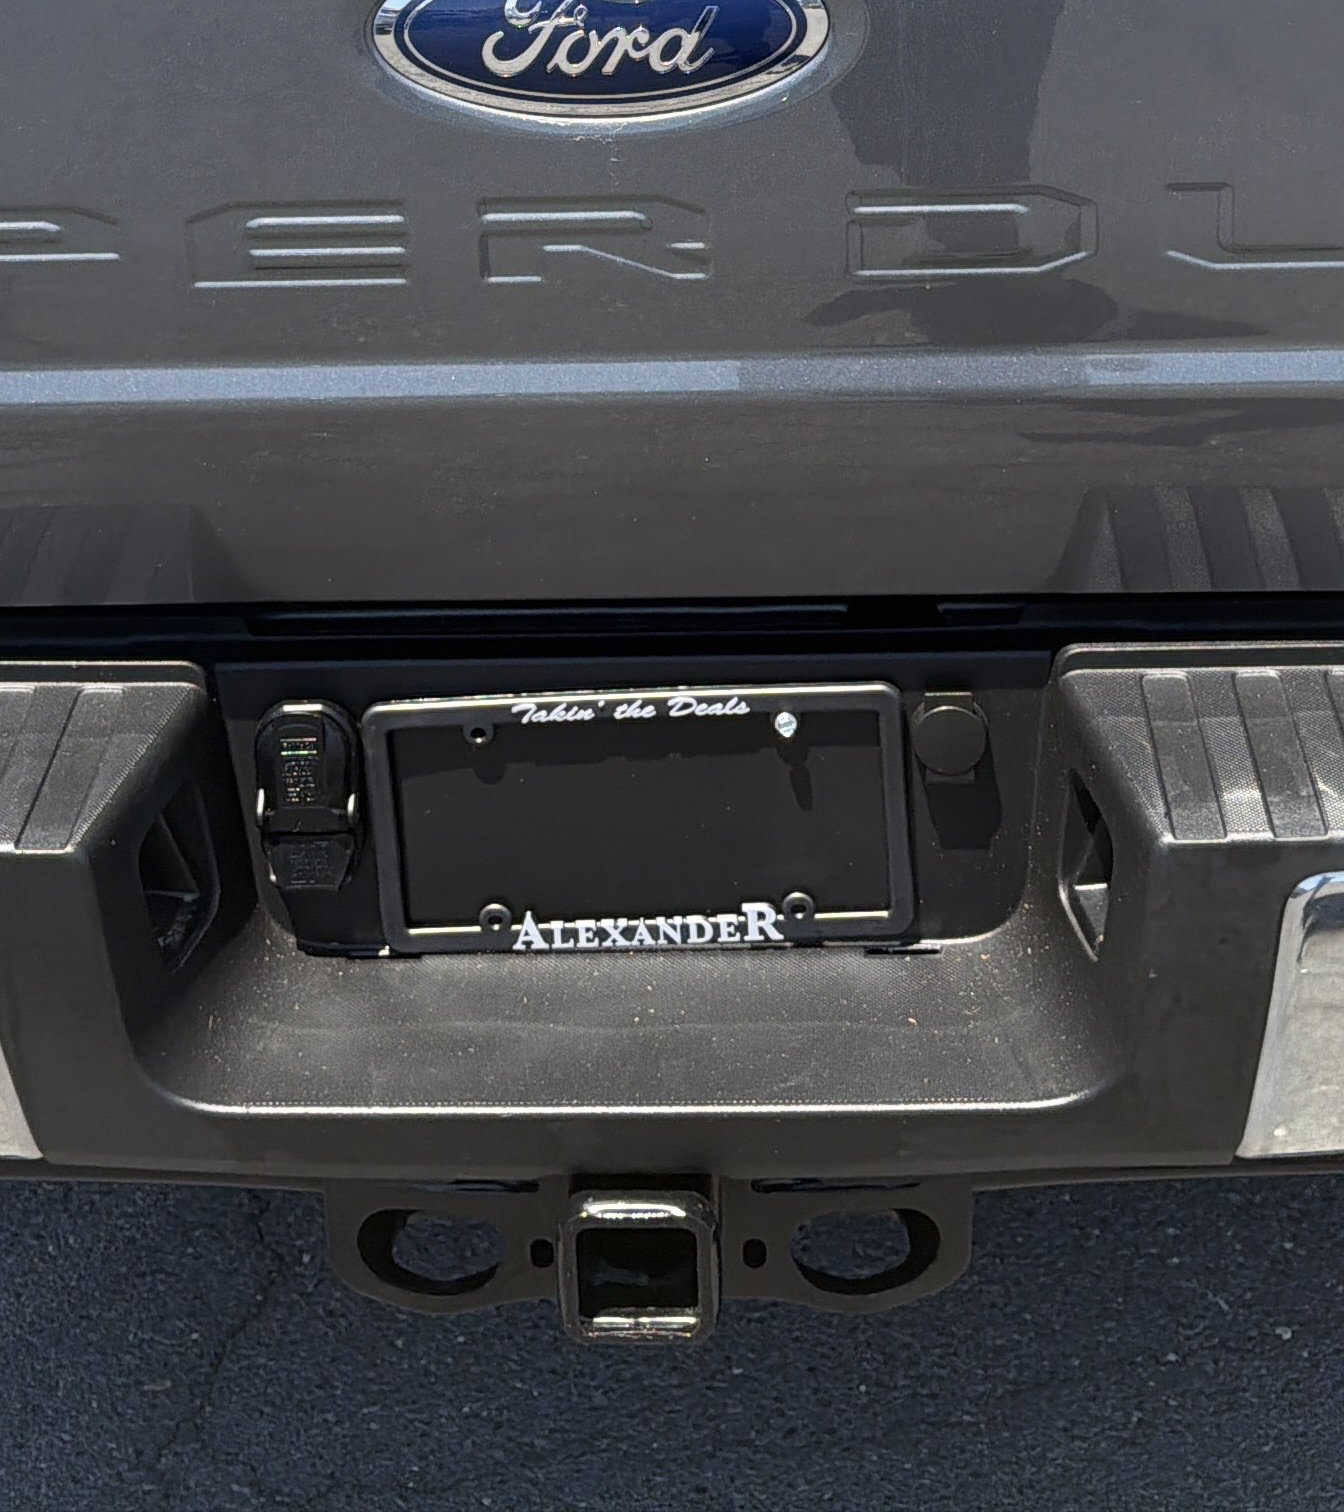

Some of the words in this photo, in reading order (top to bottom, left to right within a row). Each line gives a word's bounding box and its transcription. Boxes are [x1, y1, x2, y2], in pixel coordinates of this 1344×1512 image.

[511, 700, 605, 724] Takin'
[613, 700, 656, 720] the
[667, 696, 750, 717] Deals
[512, 902, 784, 950] ALEXANDER
